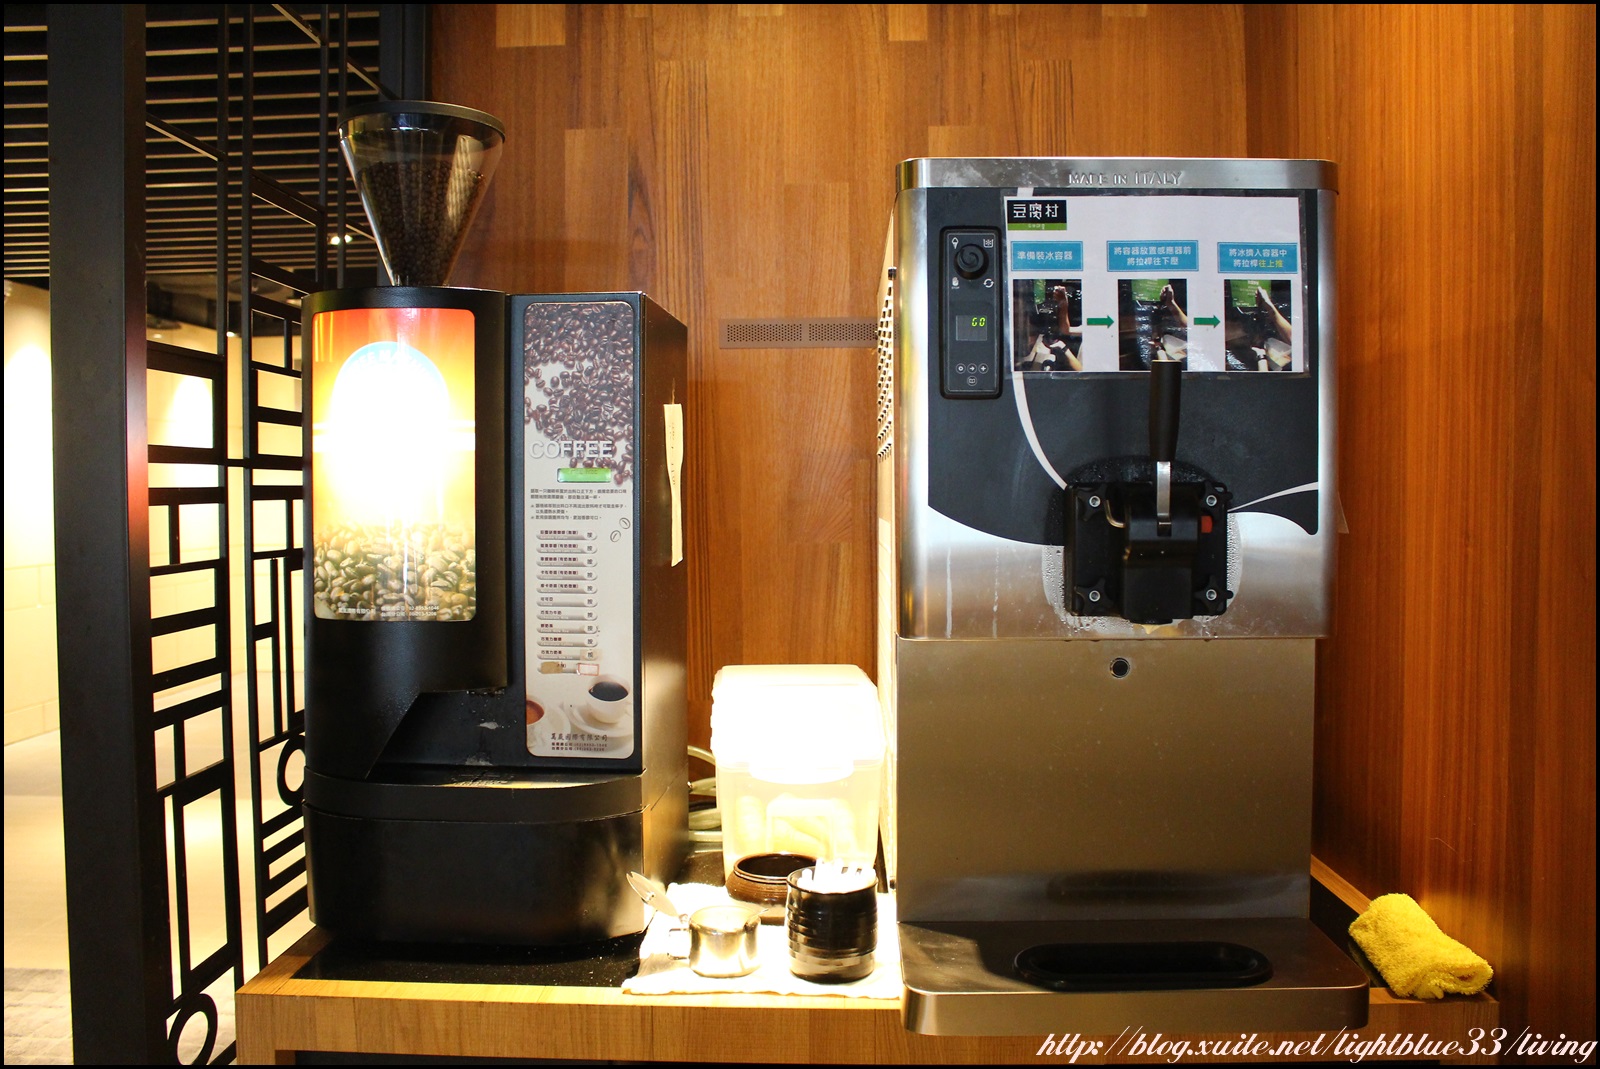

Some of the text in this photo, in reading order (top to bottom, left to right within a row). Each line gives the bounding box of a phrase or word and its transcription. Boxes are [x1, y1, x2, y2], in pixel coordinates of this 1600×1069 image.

[1068, 170, 1184, 185] MADE IN ITALY
[1013, 203, 1059, 220] 豆腐村
[529, 440, 613, 459] COFFEE
